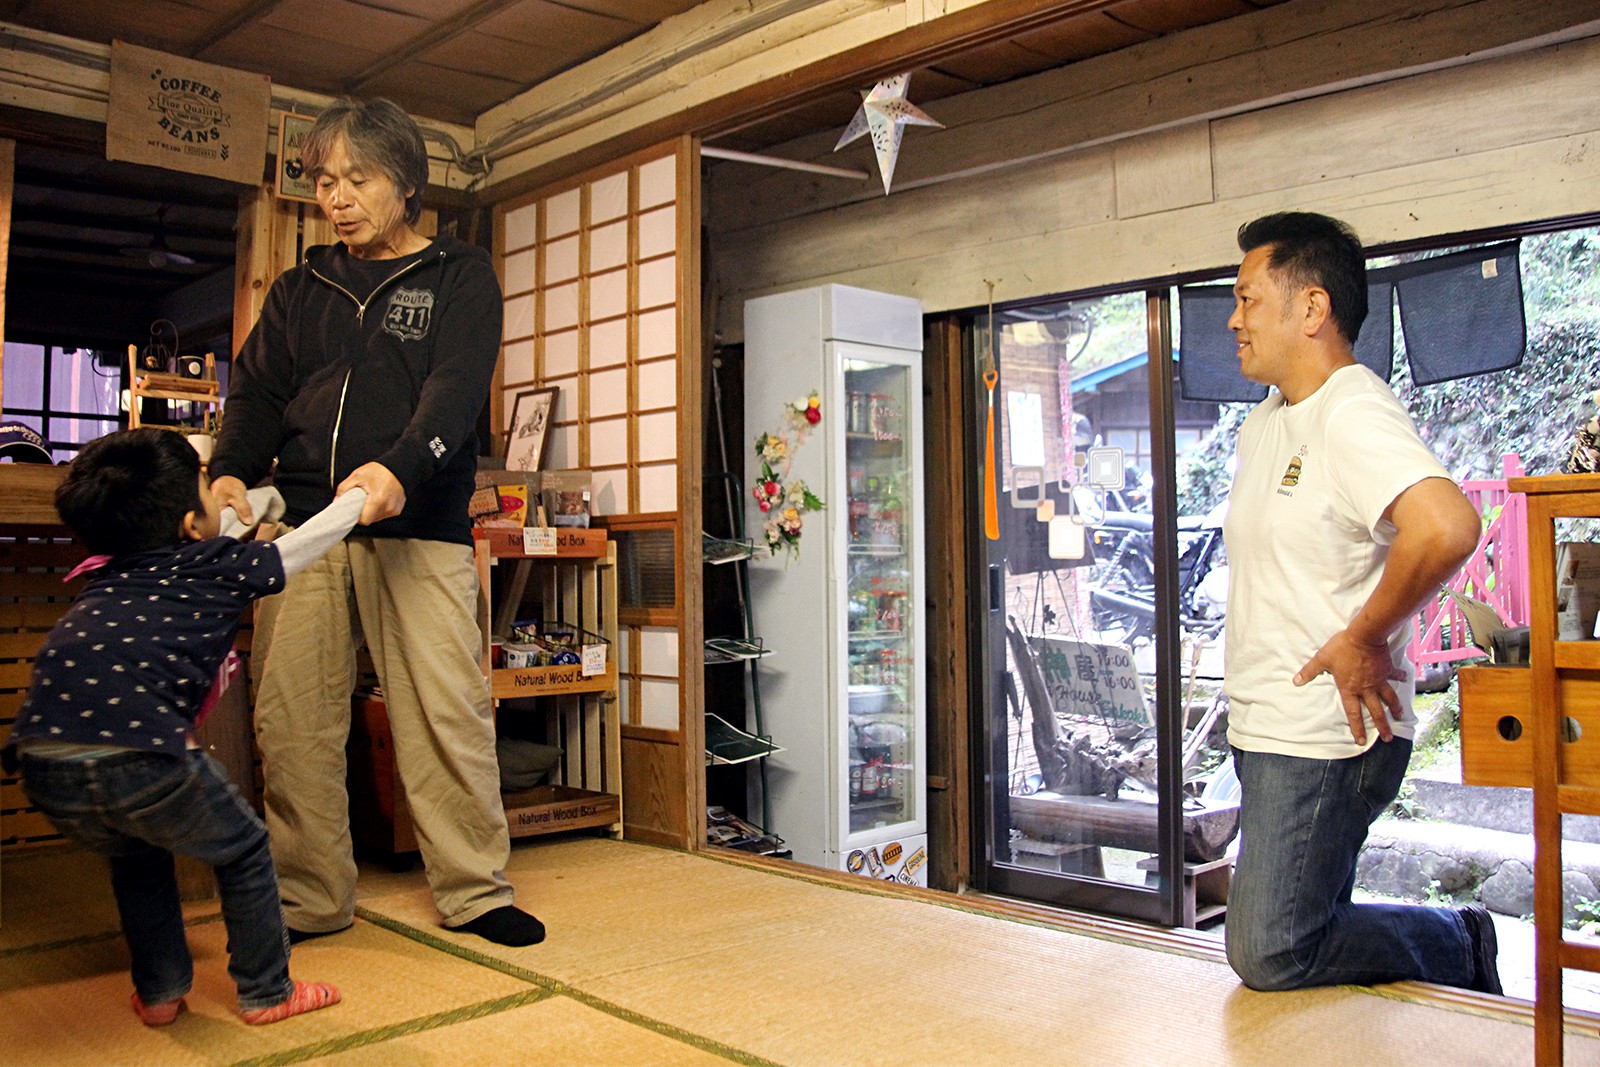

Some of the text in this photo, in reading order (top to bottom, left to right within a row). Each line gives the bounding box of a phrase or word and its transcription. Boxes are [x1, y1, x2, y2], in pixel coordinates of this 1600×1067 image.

[161, 78, 221, 103] COFFEE
[162, 97, 179, 109] Fine
[183, 102, 218, 118] Quality
[158, 116, 220, 143] BEANS
[396, 293, 429, 304] ROUTE
[569, 534, 585, 546] Box
[514, 673, 546, 687] Natural
[549, 671, 574, 685] Wood
[1055, 685, 1102, 705] House
[518, 805, 597, 825] Natural Wood Box
